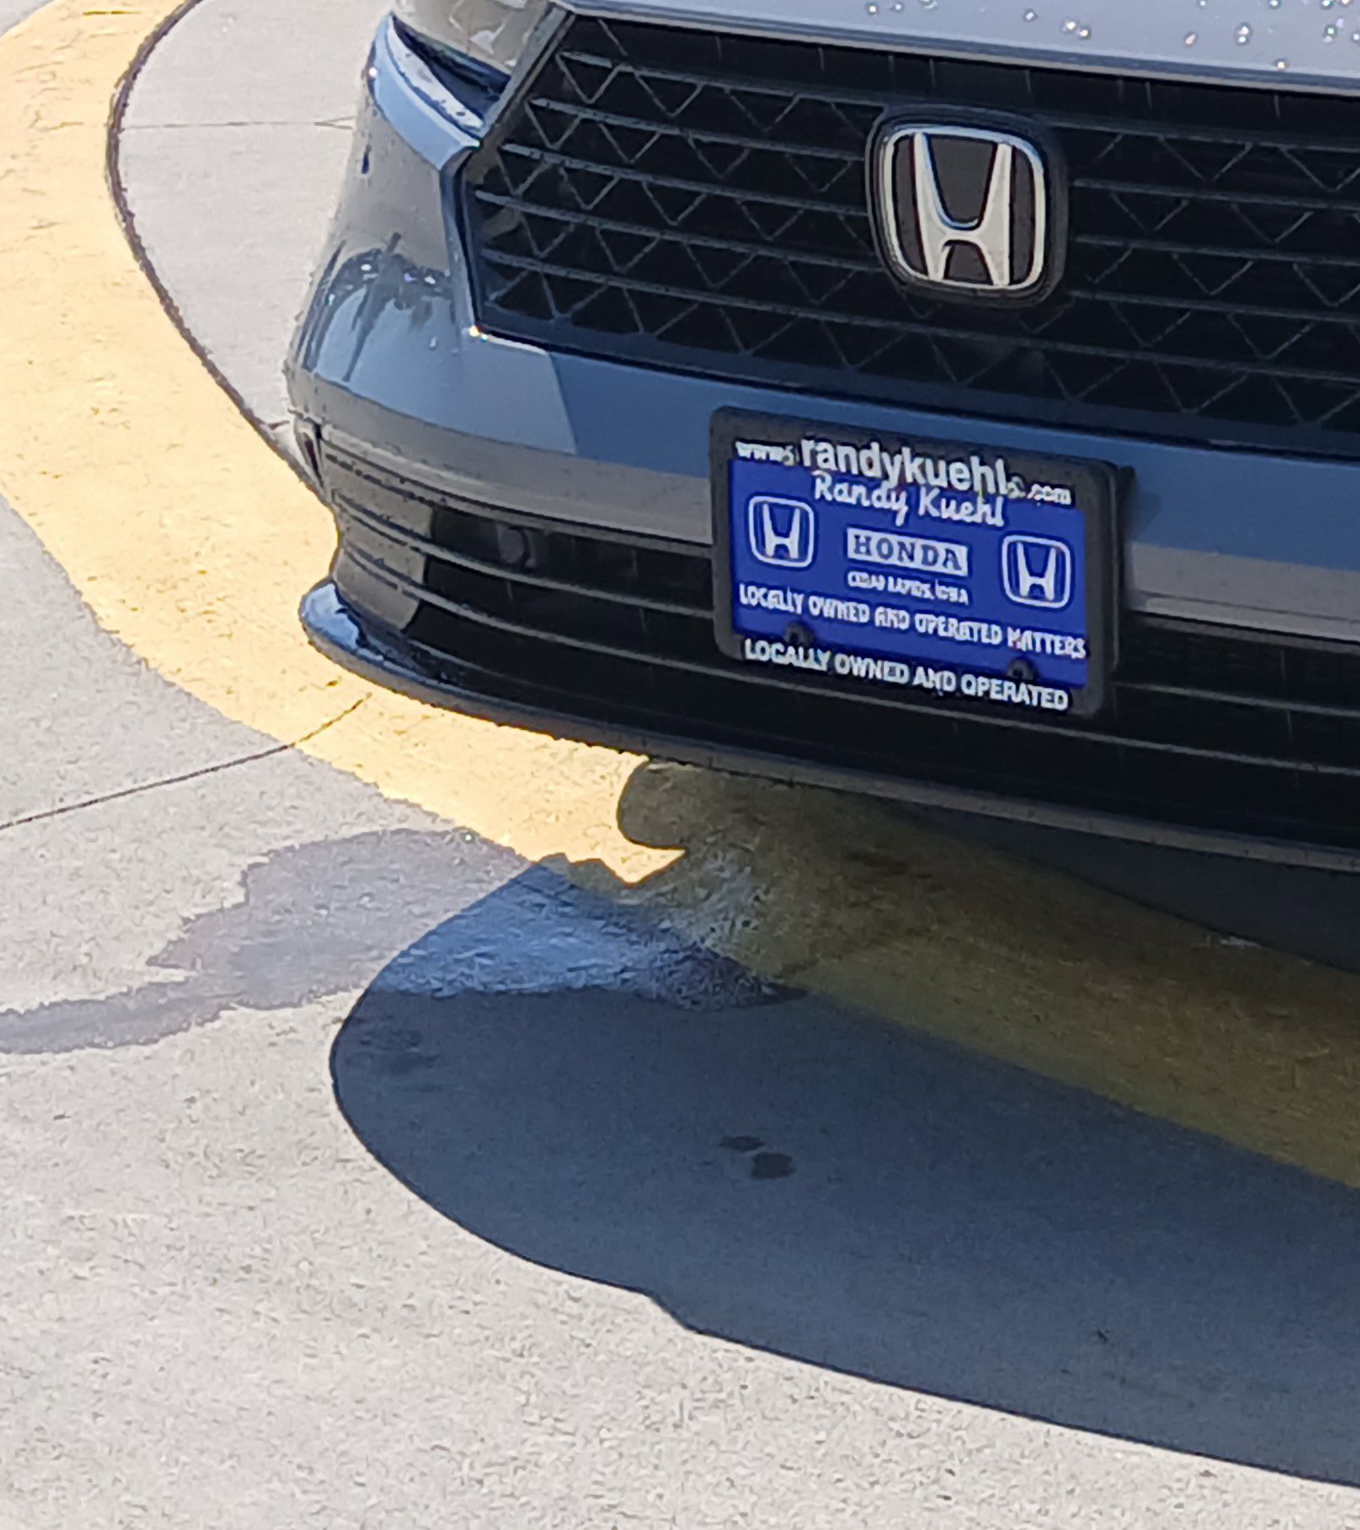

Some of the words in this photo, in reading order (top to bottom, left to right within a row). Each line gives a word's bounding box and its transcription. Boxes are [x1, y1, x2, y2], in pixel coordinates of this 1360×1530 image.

[811, 470, 908, 527] Randy
[918, 486, 1005, 527] Kuehl
[853, 534, 962, 570] HONDA
[808, 595, 870, 623] OWNED
[874, 606, 910, 630] AND
[914, 613, 1003, 644] OPERATED
[1007, 626, 1087, 659] MATTERS
[745, 638, 831, 671] LOCALLY
[834, 653, 909, 684] OWNED
[912, 666, 957, 693] AND
[961, 674, 1069, 711] OPERATED
